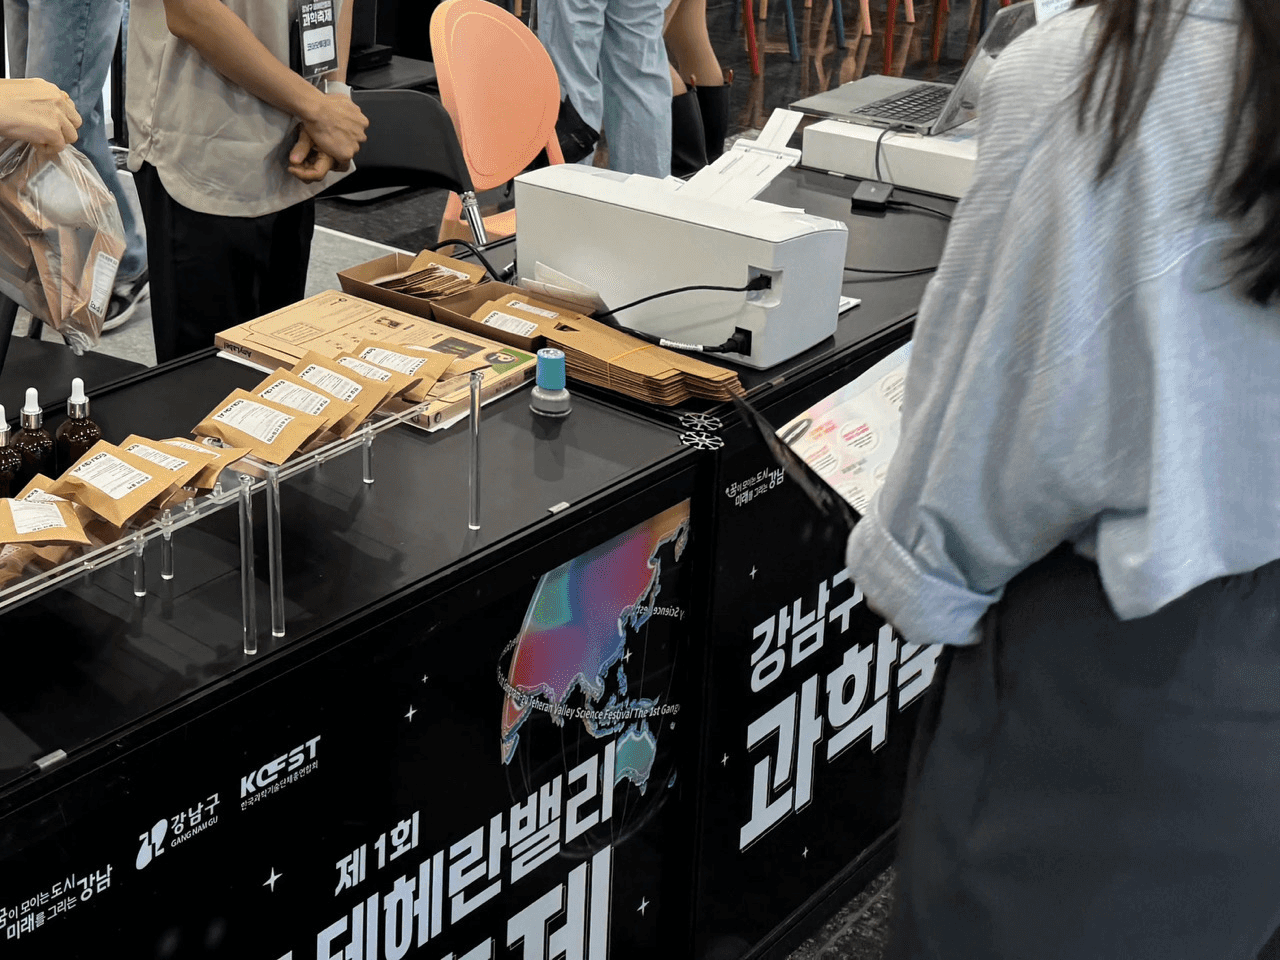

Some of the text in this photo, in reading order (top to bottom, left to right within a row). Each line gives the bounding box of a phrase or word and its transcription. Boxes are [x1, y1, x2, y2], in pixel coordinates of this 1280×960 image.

[575, 707, 603, 720] Science
[604, 706, 633, 719] Festival
[171, 793, 220, 835] 강남구
[334, 810, 420, 897] 제 1회
[20, 892, 50, 915] 모이는
[50, 873, 76, 899] 도시
[76, 863, 113, 902] 강남
[6, 896, 78, 940] 미래를 그리는
